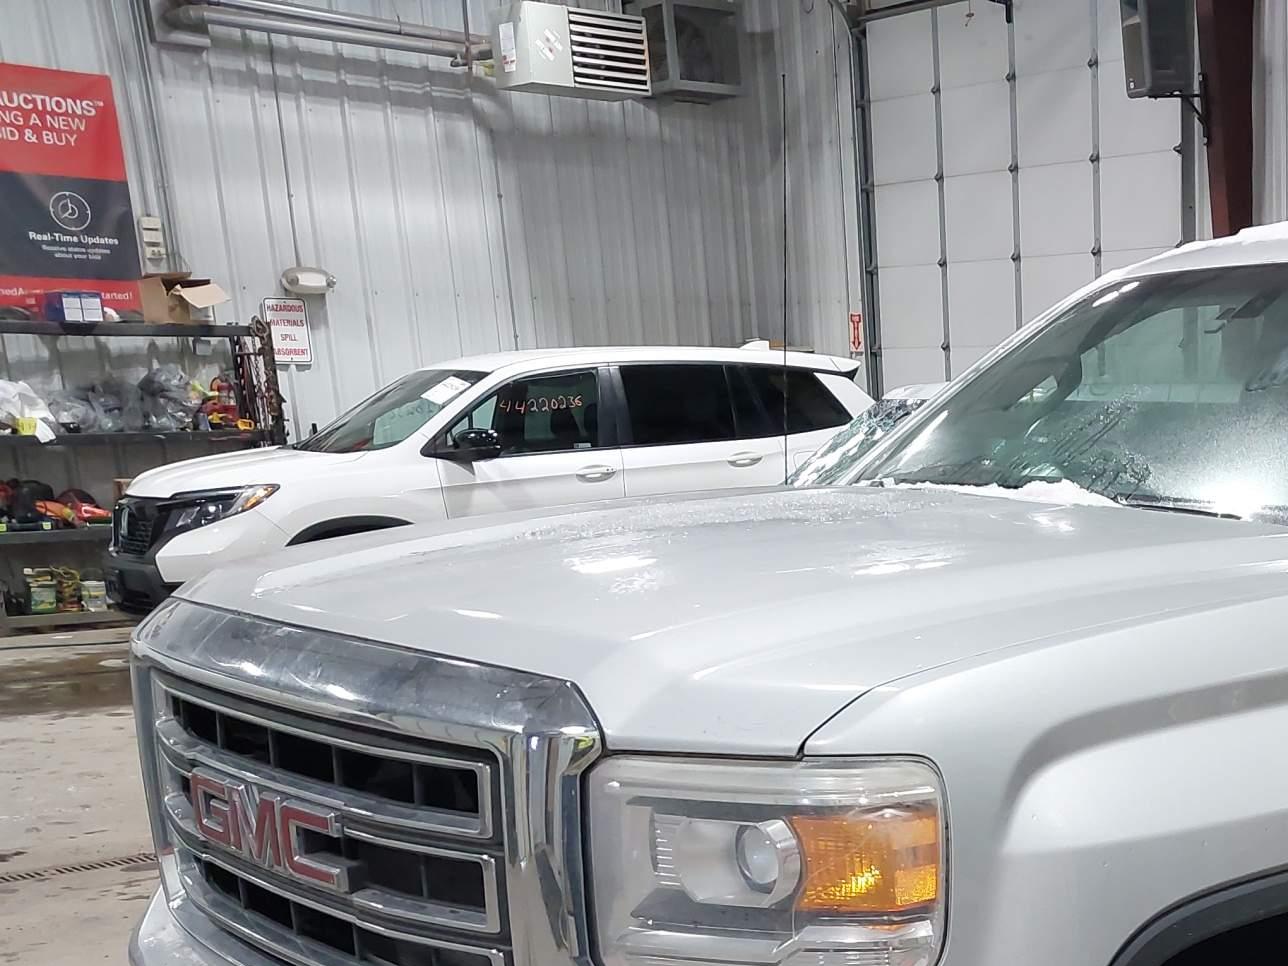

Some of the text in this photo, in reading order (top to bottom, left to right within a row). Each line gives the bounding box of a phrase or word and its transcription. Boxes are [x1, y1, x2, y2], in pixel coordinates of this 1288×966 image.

[29, 112, 42, 127] A
[45, 114, 86, 131] NEW
[0, 126, 77, 147] ID & BUY
[28, 231, 119, 245] Real-Time Updates
[101, 290, 133, 300] tarted!
[266, 303, 304, 313] HAZARDOUS
[269, 318, 305, 328] MATERIALS
[280, 333, 298, 342] SPILL
[499, 395, 584, 414] 44220236
[190, 767, 350, 893] GMC
